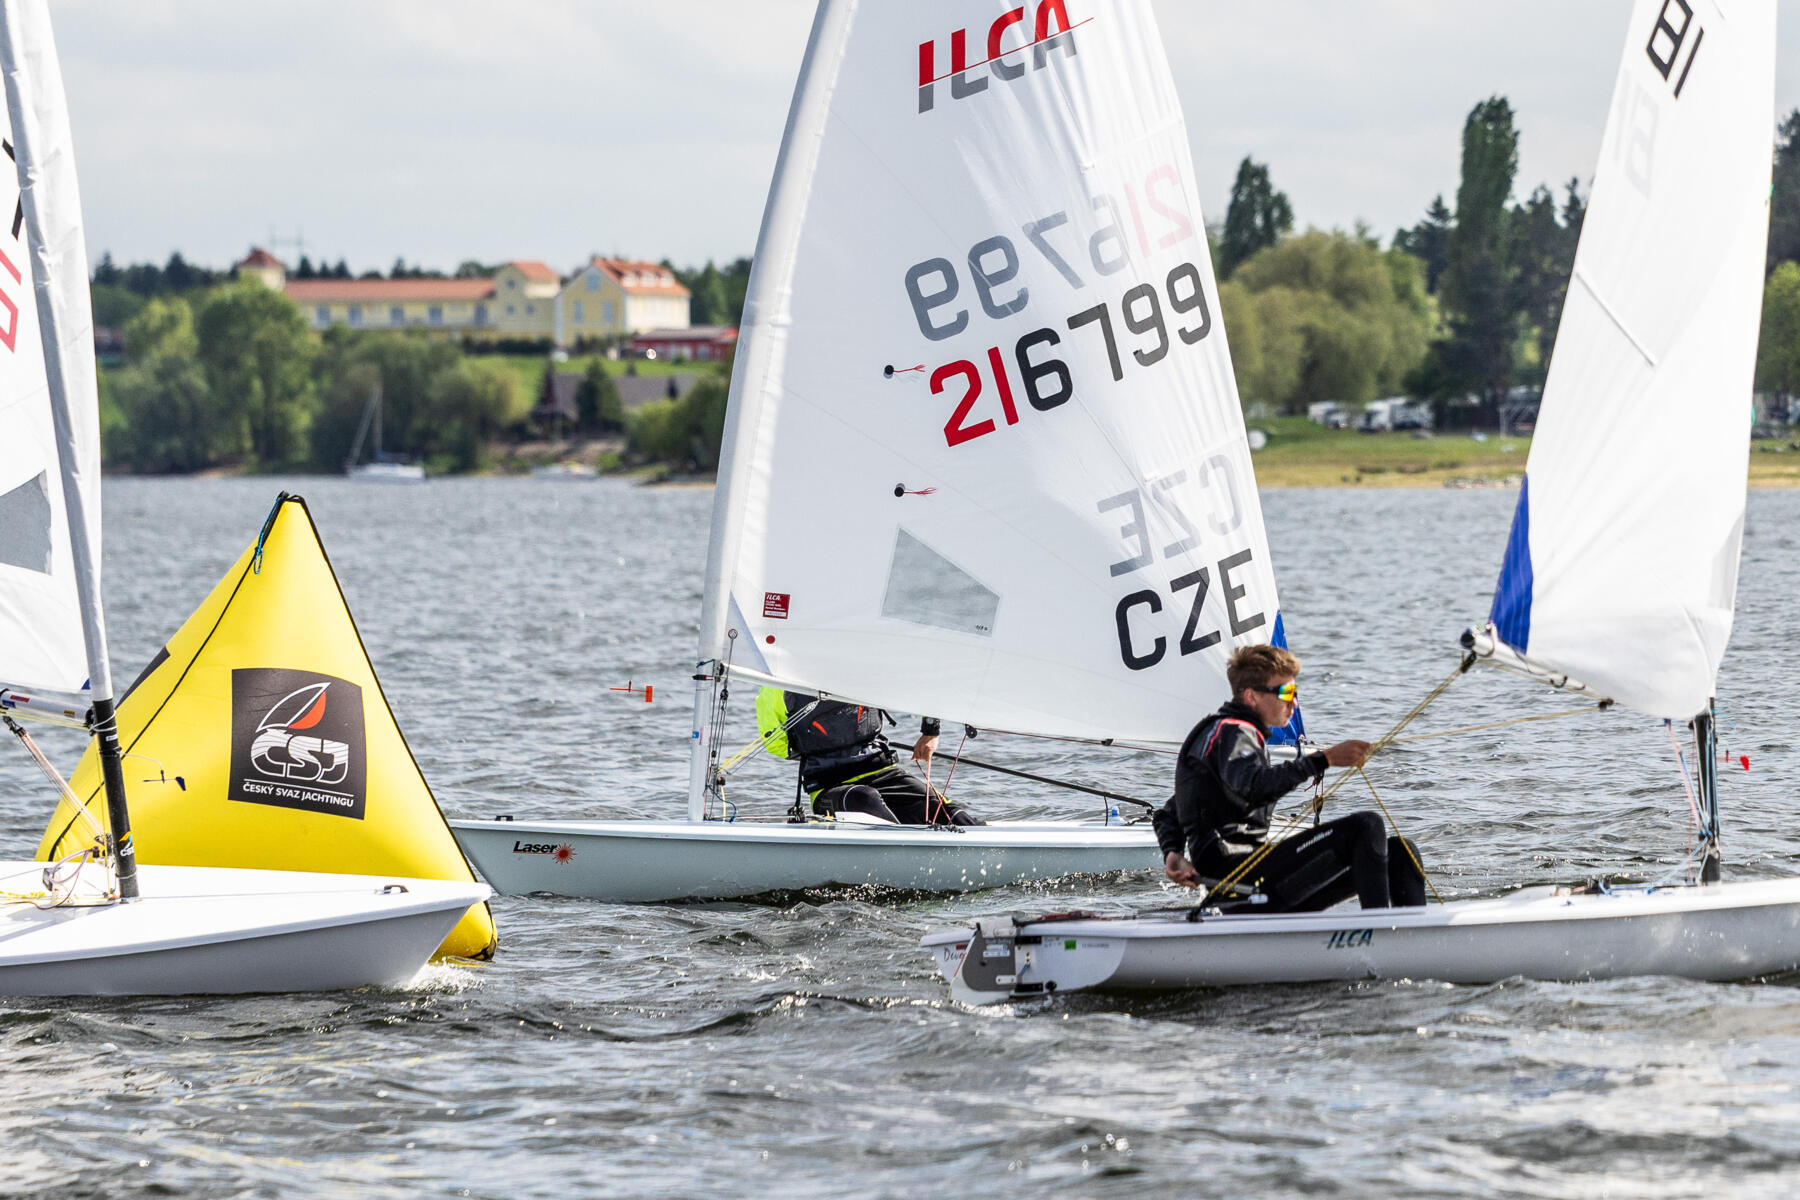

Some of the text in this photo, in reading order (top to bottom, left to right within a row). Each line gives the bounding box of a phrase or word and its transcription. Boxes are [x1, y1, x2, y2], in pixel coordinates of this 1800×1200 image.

[918, 0, 1078, 114] ILCA
[930, 262, 1212, 447] 216799
[1115, 548, 1266, 670] CZE
[243, 782, 354, 808] ČESKÝ SVAZ JACHTINGU
[513, 841, 557, 854] Laser
[1327, 928, 1373, 949] ILCA
